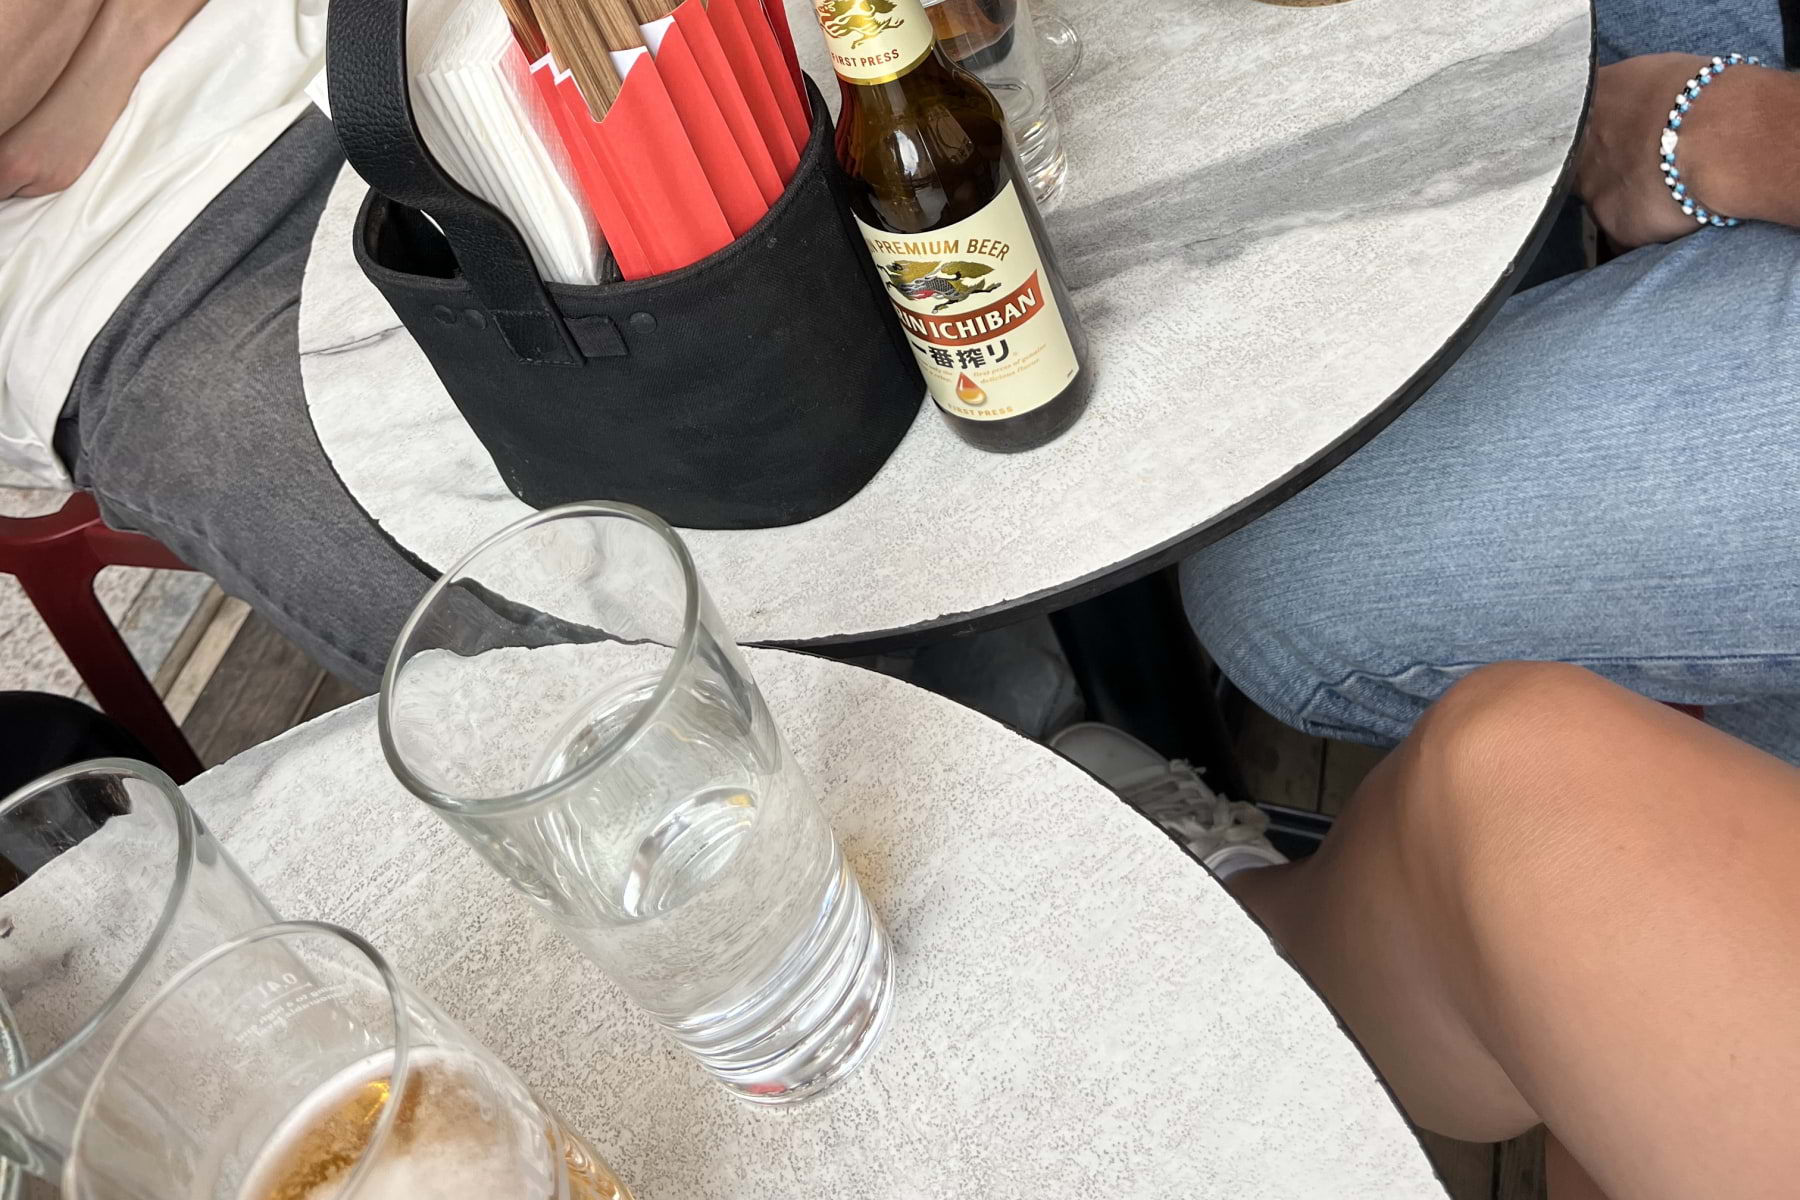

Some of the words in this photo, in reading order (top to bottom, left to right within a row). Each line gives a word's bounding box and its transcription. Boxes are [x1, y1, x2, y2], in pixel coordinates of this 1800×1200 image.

[831, 52, 857, 67] FIRST
[860, 48, 900, 67] PRESS
[875, 239, 959, 255] PREMIUM
[966, 238, 1010, 261] BEER
[896, 308, 928, 336] RIN
[928, 287, 1037, 340] ICHIBAN
[978, 406, 1014, 417] PRESS
